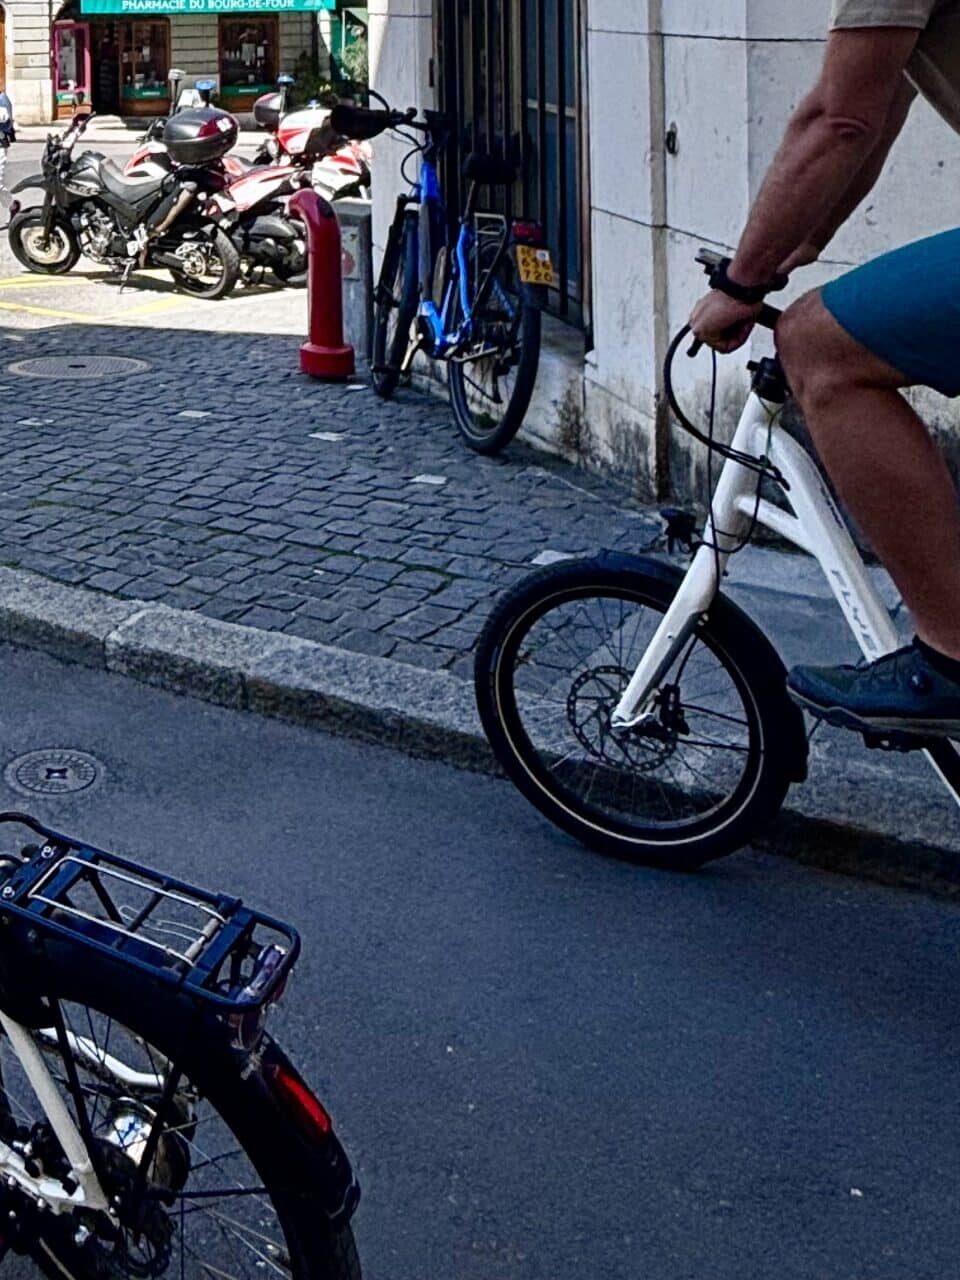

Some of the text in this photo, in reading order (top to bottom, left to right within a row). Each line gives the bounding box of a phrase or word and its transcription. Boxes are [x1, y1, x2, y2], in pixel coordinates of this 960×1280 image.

[122, 0, 185, 10] PHARMACIE
[188, 0, 204, 9] DU
[830, 569, 878, 655] FLYE
